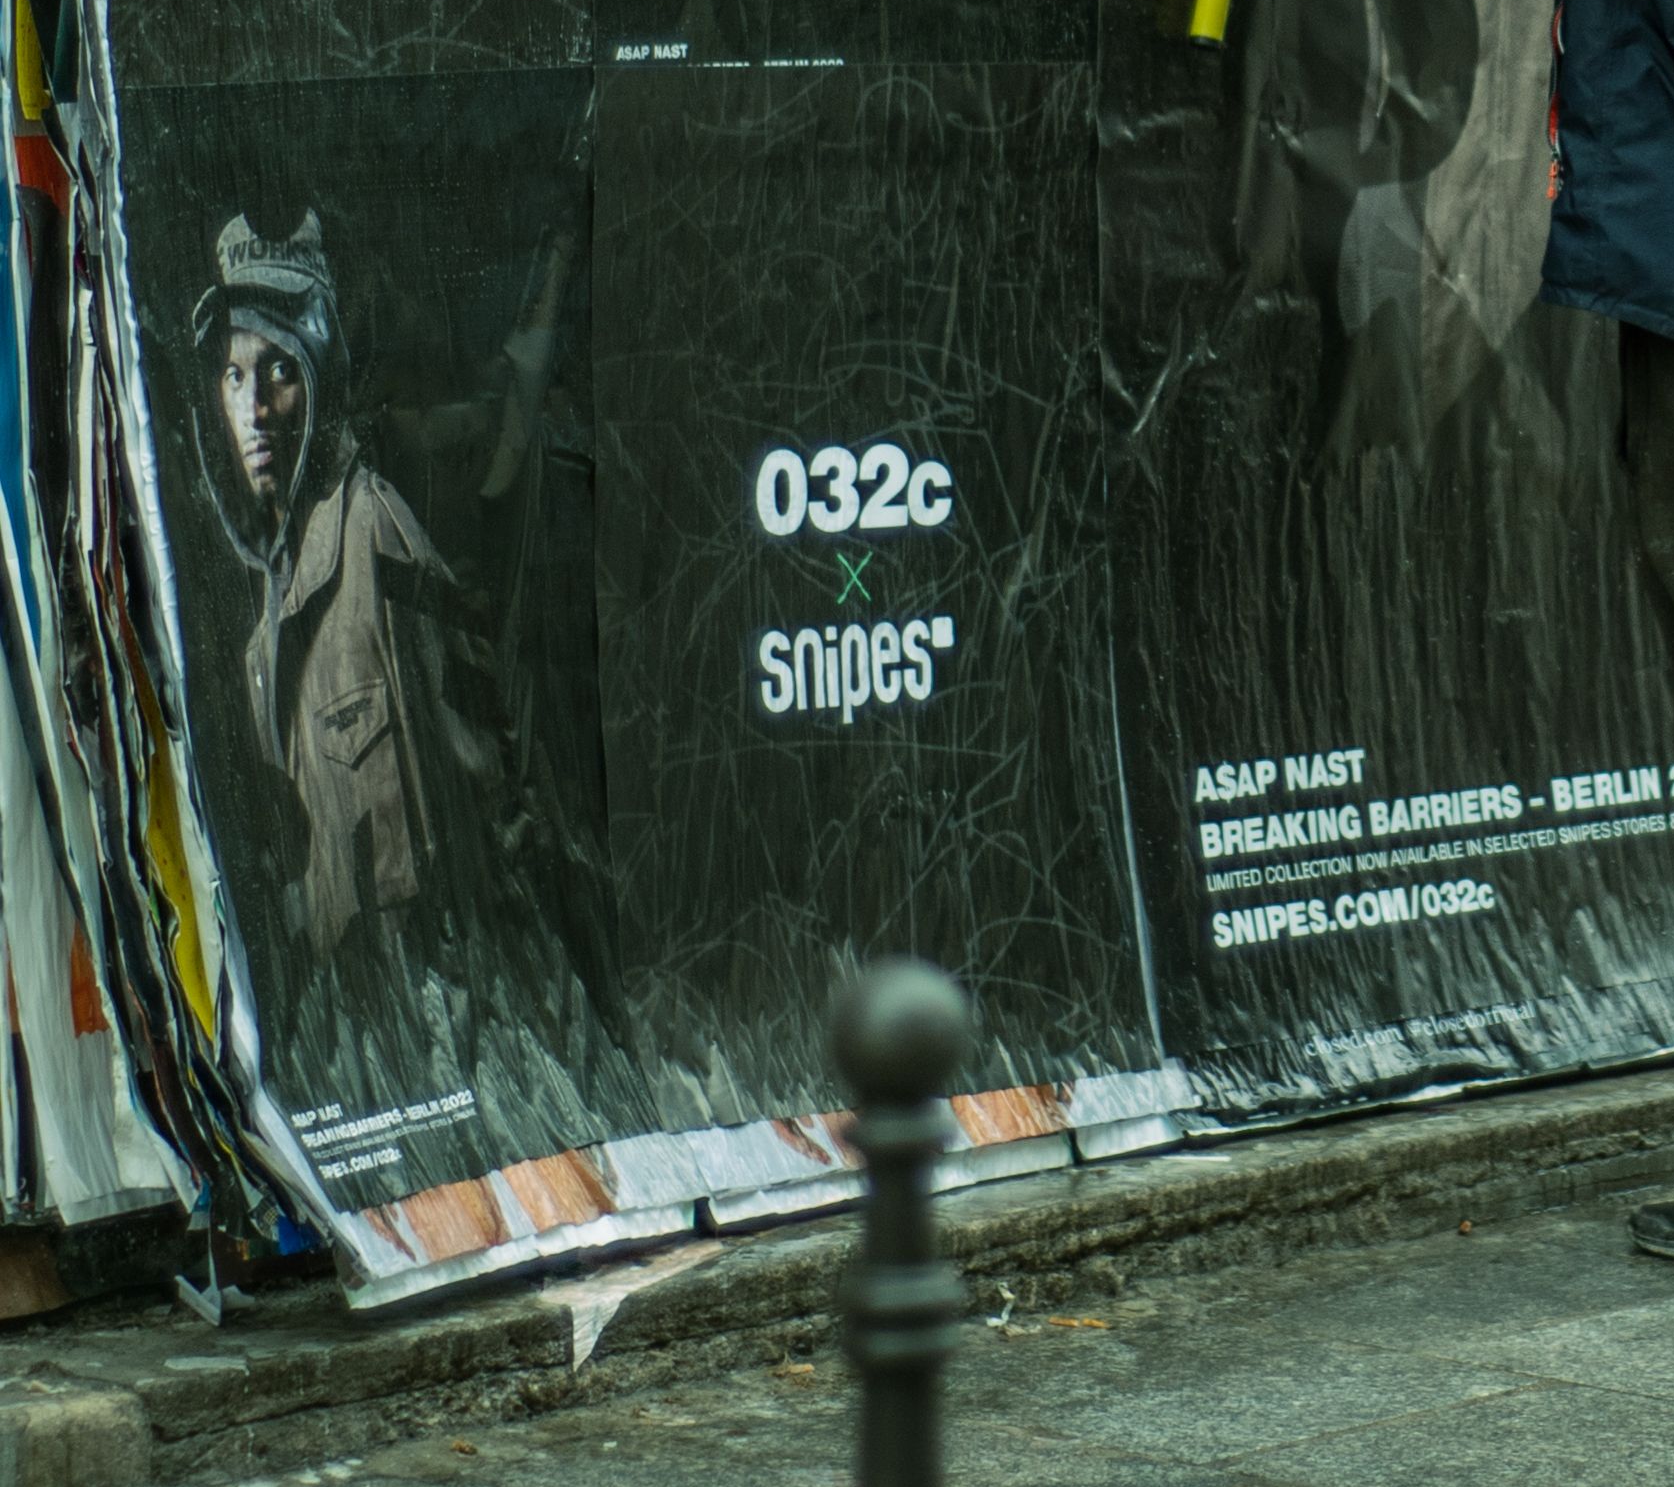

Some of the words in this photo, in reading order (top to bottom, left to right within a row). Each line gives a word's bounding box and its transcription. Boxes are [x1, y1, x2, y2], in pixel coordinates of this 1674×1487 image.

[653, 43, 689, 60] NAST
[755, 442, 954, 537] 032c
[758, 617, 934, 725] snipes
[1284, 748, 1366, 792] NAST
[1200, 805, 1363, 859] BREAKING
[1368, 784, 1523, 837] BARRIERS
[1551, 766, 1662, 813] BERLIN
[1206, 869, 1263, 893] LIMITED
[1264, 856, 1353, 885] COLLECTION
[1355, 850, 1388, 872] NOW
[1390, 840, 1465, 867] AVAILABLE
[1466, 838, 1483, 857] IN
[1485, 828, 1557, 855] SELECTED
[1558, 822, 1612, 845] SNIPES
[1612, 814, 1666, 837] STORES
[1212, 878, 1495, 948] SNIPES.COM/032c
[440, 1089, 475, 1113] 2022
